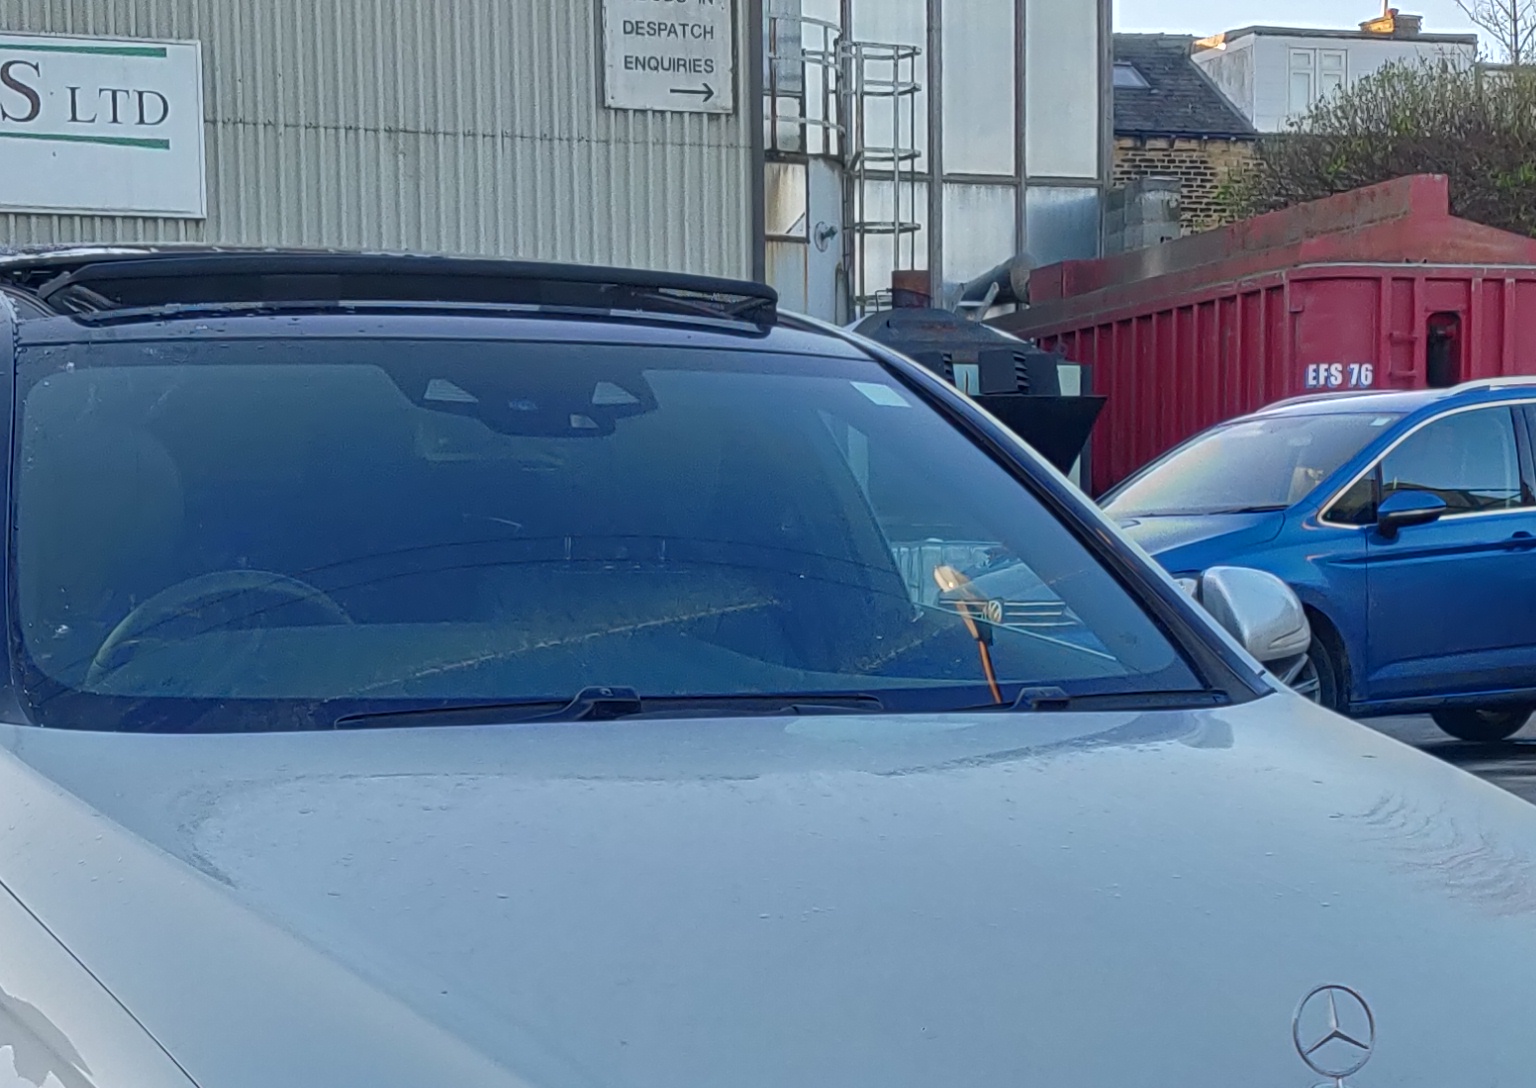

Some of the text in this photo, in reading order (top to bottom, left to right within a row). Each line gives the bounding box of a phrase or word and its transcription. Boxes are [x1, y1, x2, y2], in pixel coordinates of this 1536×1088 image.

[623, 20, 714, 40] DESPATCH
[624, 54, 715, 74] ENQUIRIES
[66, 85, 171, 126] LTD
[1306, 363, 1373, 388] EFS 76
